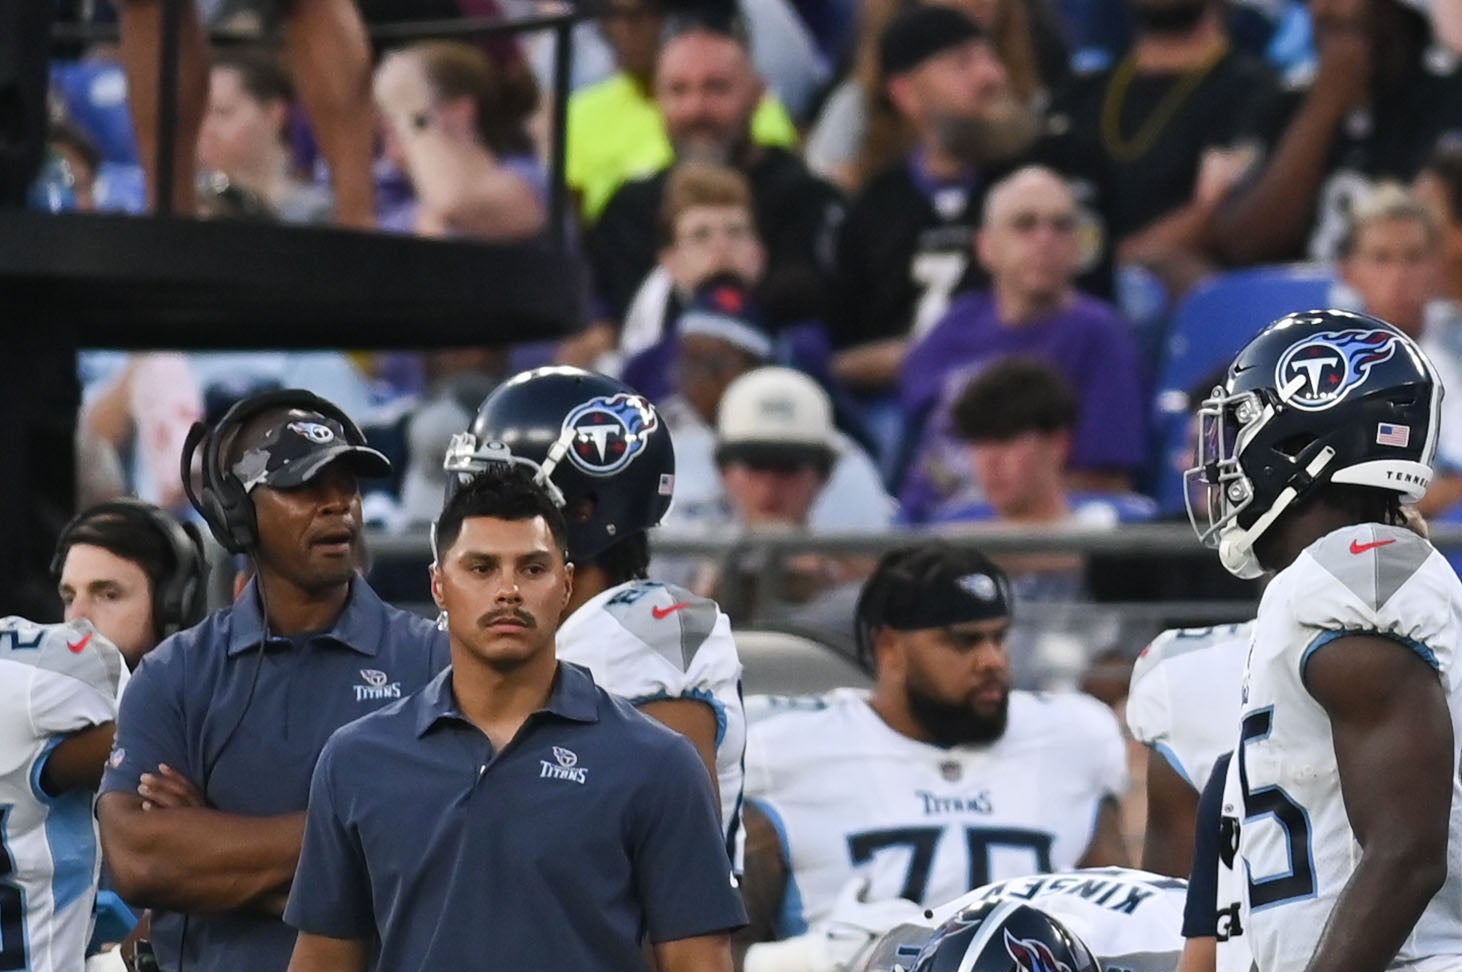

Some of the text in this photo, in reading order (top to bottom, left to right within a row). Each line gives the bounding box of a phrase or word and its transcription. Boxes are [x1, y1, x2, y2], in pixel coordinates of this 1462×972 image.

[353, 682, 401, 701] TITANS
[540, 760, 589, 784] TITANS
[915, 790, 993, 814] TITANS
